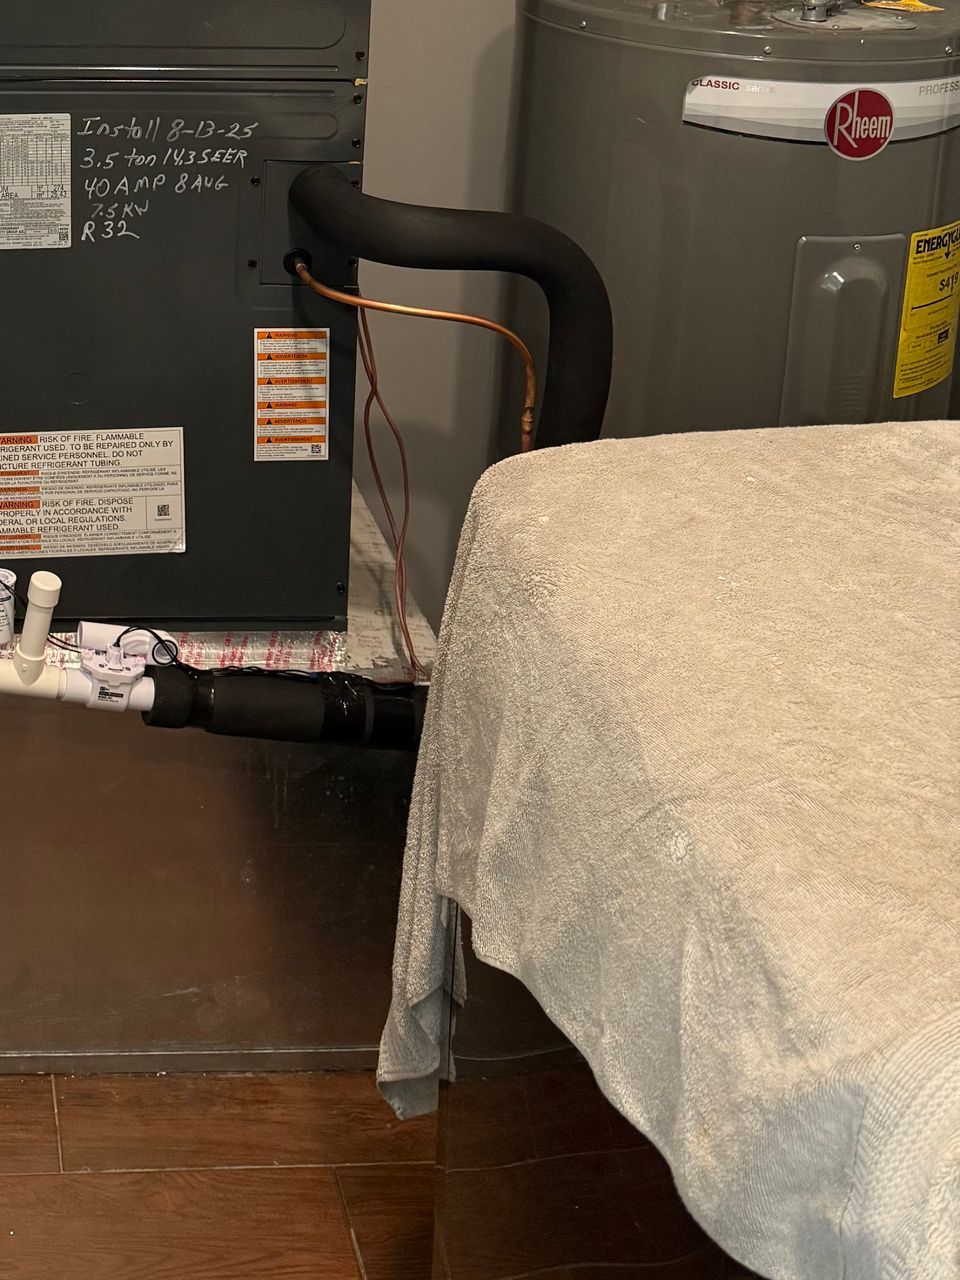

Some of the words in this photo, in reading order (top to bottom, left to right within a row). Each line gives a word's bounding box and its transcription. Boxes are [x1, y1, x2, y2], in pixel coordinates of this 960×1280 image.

[691, 79, 740, 91] CLASSIC
[832, 90, 891, 149] Rheem
[76, 116, 161, 143] Install
[166, 118, 260, 142] 8-13-25
[79, 147, 120, 170] 3.5
[124, 147, 157, 168] ton
[197, 147, 248, 168] SEER
[84, 177, 110, 201] 40
[113, 173, 166, 196] AMP
[174, 172, 189, 194] 8
[90, 202, 119, 219] 7.5
[81, 220, 96, 243] R
[101, 220, 141, 239] 32
[39, 435, 59, 443] RISK
[95, 432, 144, 441] FLAMMABLE
[43, 444, 68, 452] USED.
[70, 443, 81, 451] TO
[95, 441, 138, 450] REPAIRED
[138, 440, 161, 448] ONLY
[162, 440, 174, 448] BY
[21, 452, 57, 461] SERVICE
[58, 451, 110, 460] PERSONNEL.
[112, 450, 125, 458] DO
[126, 449, 143, 457] NOT
[30, 460, 89, 469] REFRIGERANT
[42, 500, 61, 508] RISK
[98, 497, 134, 506] DISPOSE
[53, 507, 109, 516] ACCORDANCE
[111, 506, 133, 514] WITH
[39, 517, 67, 525] LOCAL
[37, 524, 94, 533] REFRIGERANT
